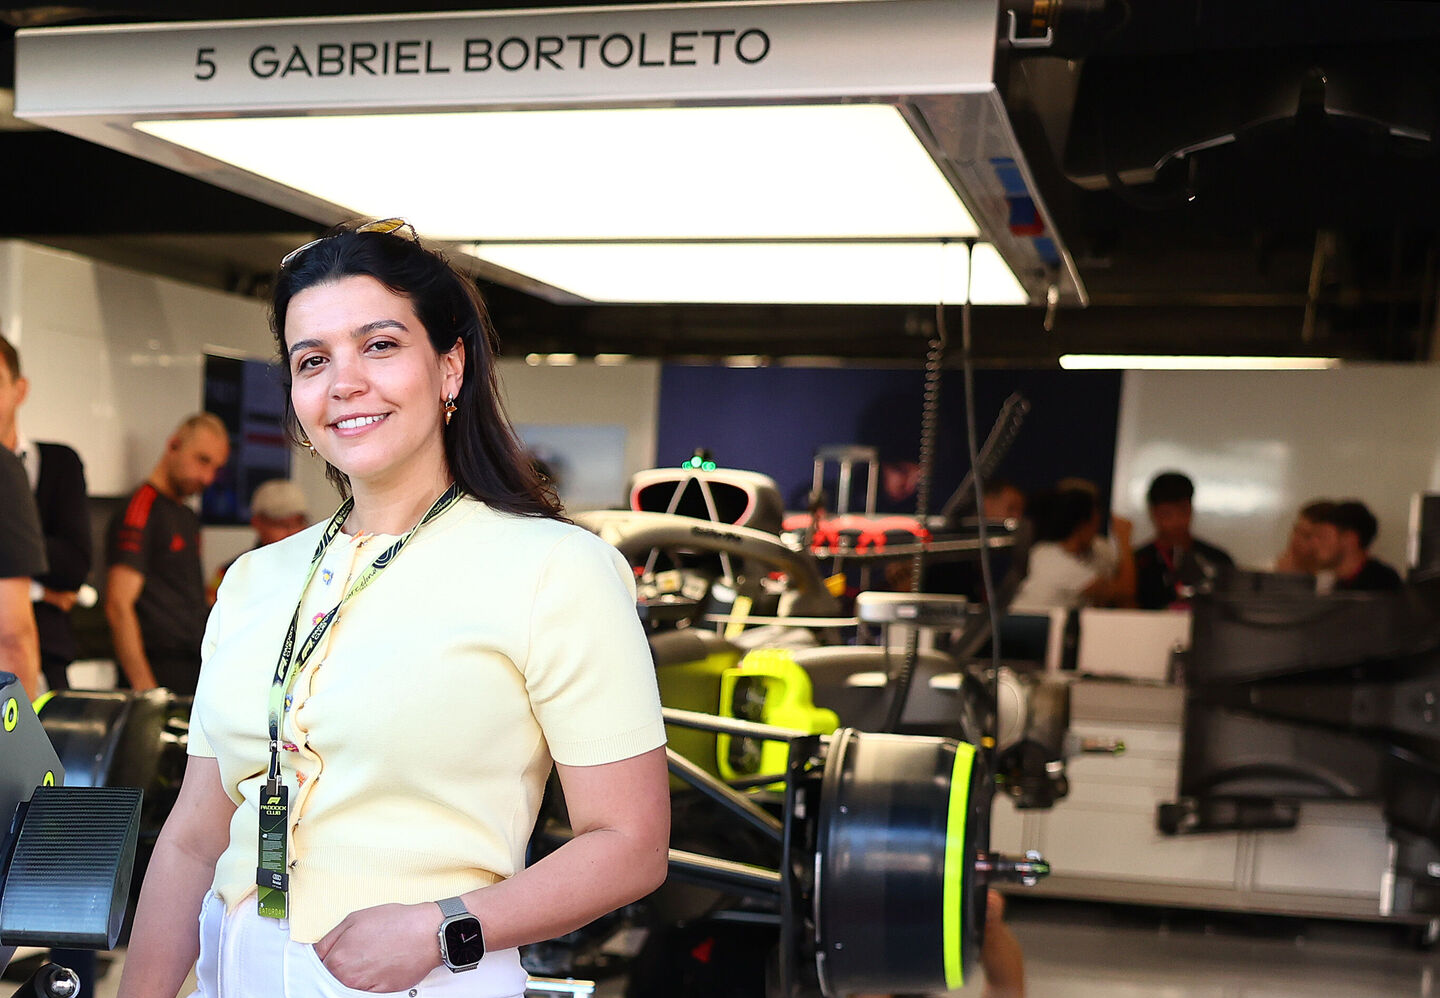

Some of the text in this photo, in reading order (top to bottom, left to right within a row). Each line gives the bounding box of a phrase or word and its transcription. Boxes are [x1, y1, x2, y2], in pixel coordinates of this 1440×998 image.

[194, 28, 771, 82] 5 GABRIEL BORTOLETO
